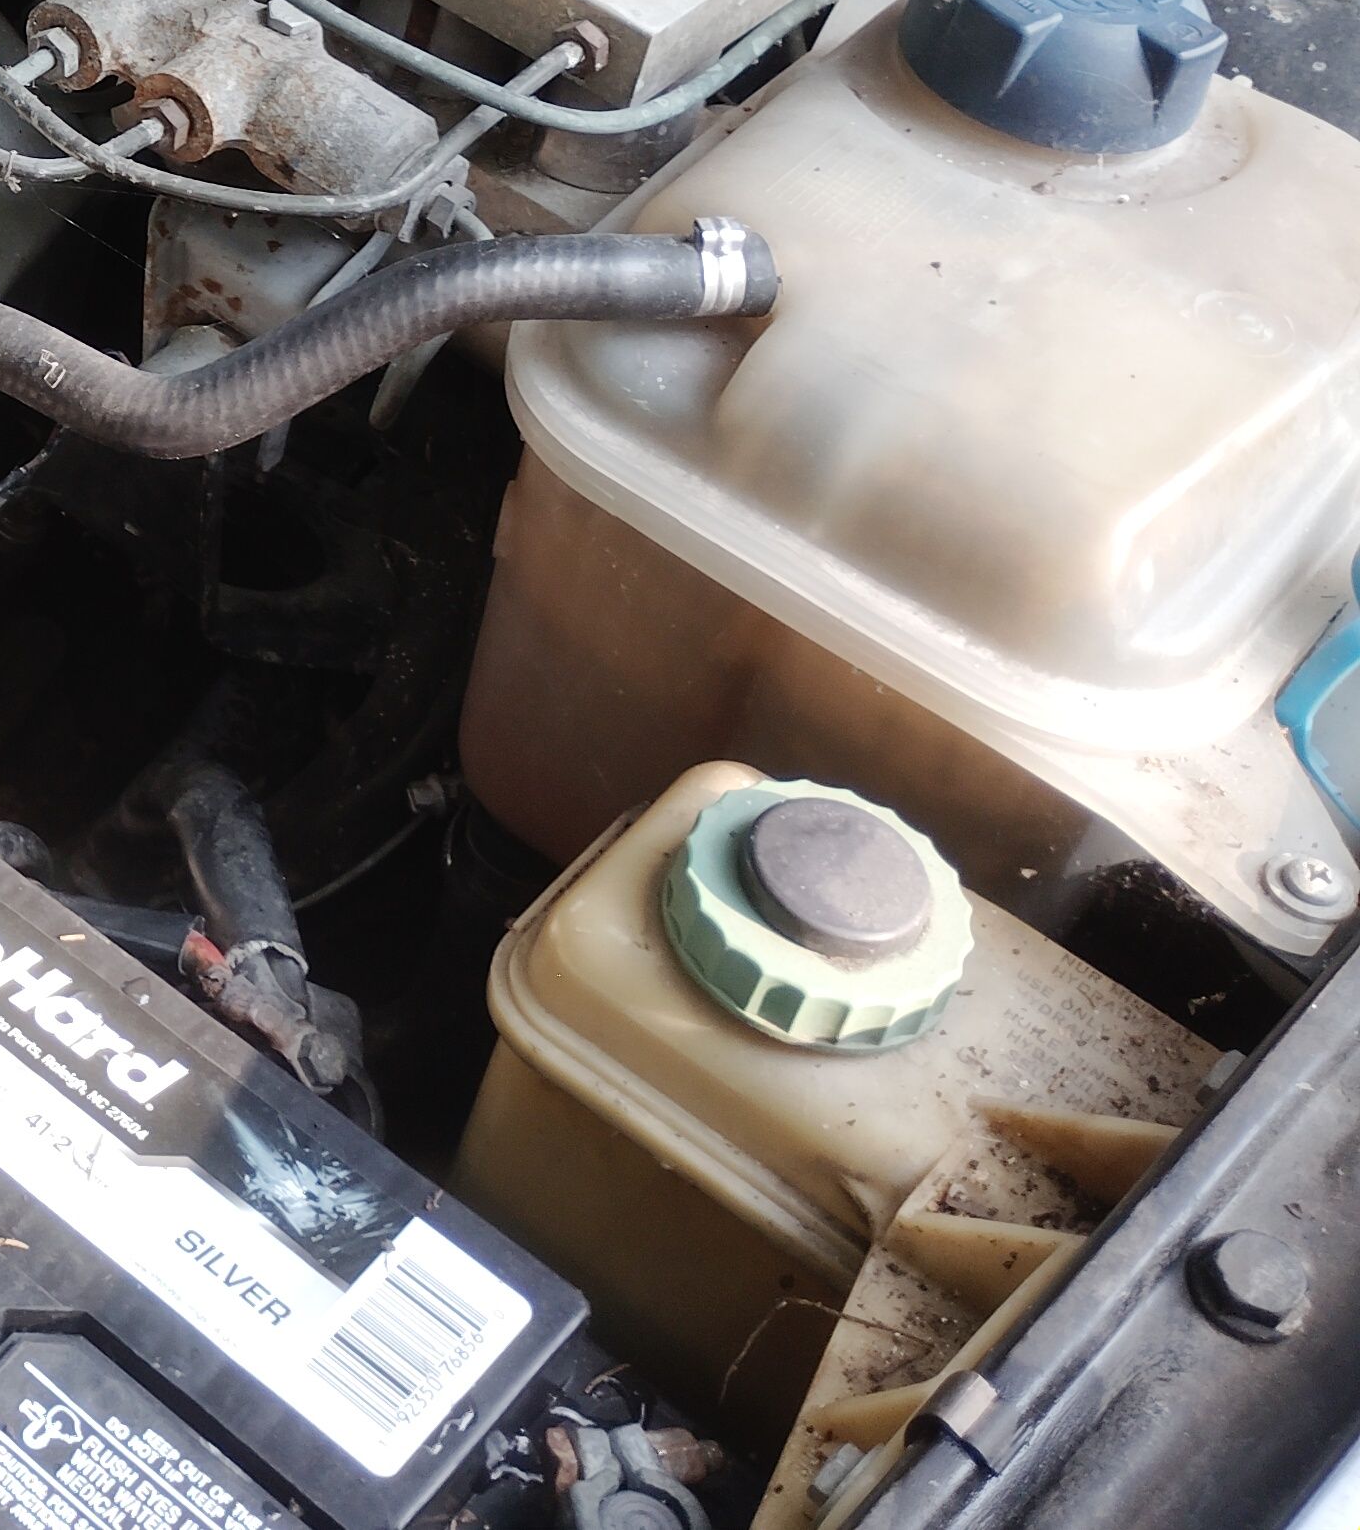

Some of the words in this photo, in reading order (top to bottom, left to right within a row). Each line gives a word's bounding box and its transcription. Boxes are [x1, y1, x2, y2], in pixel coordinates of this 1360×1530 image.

[1017, 970, 1054, 999] USE
[8, 1028, 41, 1059] Parts,
[87, 1091, 109, 1109] NC
[175, 1229, 291, 1326] SILVER
[57, 1464, 125, 1530] MEDICAL
[71, 1449, 115, 1492] WITH
[82, 1435, 138, 1487] FLUSH
[135, 1481, 181, 1524] EYES
[106, 1417, 130, 1440] DO
[128, 1435, 159, 1463] NOT
[187, 1486, 224, 1517] KEEP
[143, 1429, 180, 1460] KEEP
[179, 1460, 211, 1487] OUT
[205, 1485, 233, 1508] OF
